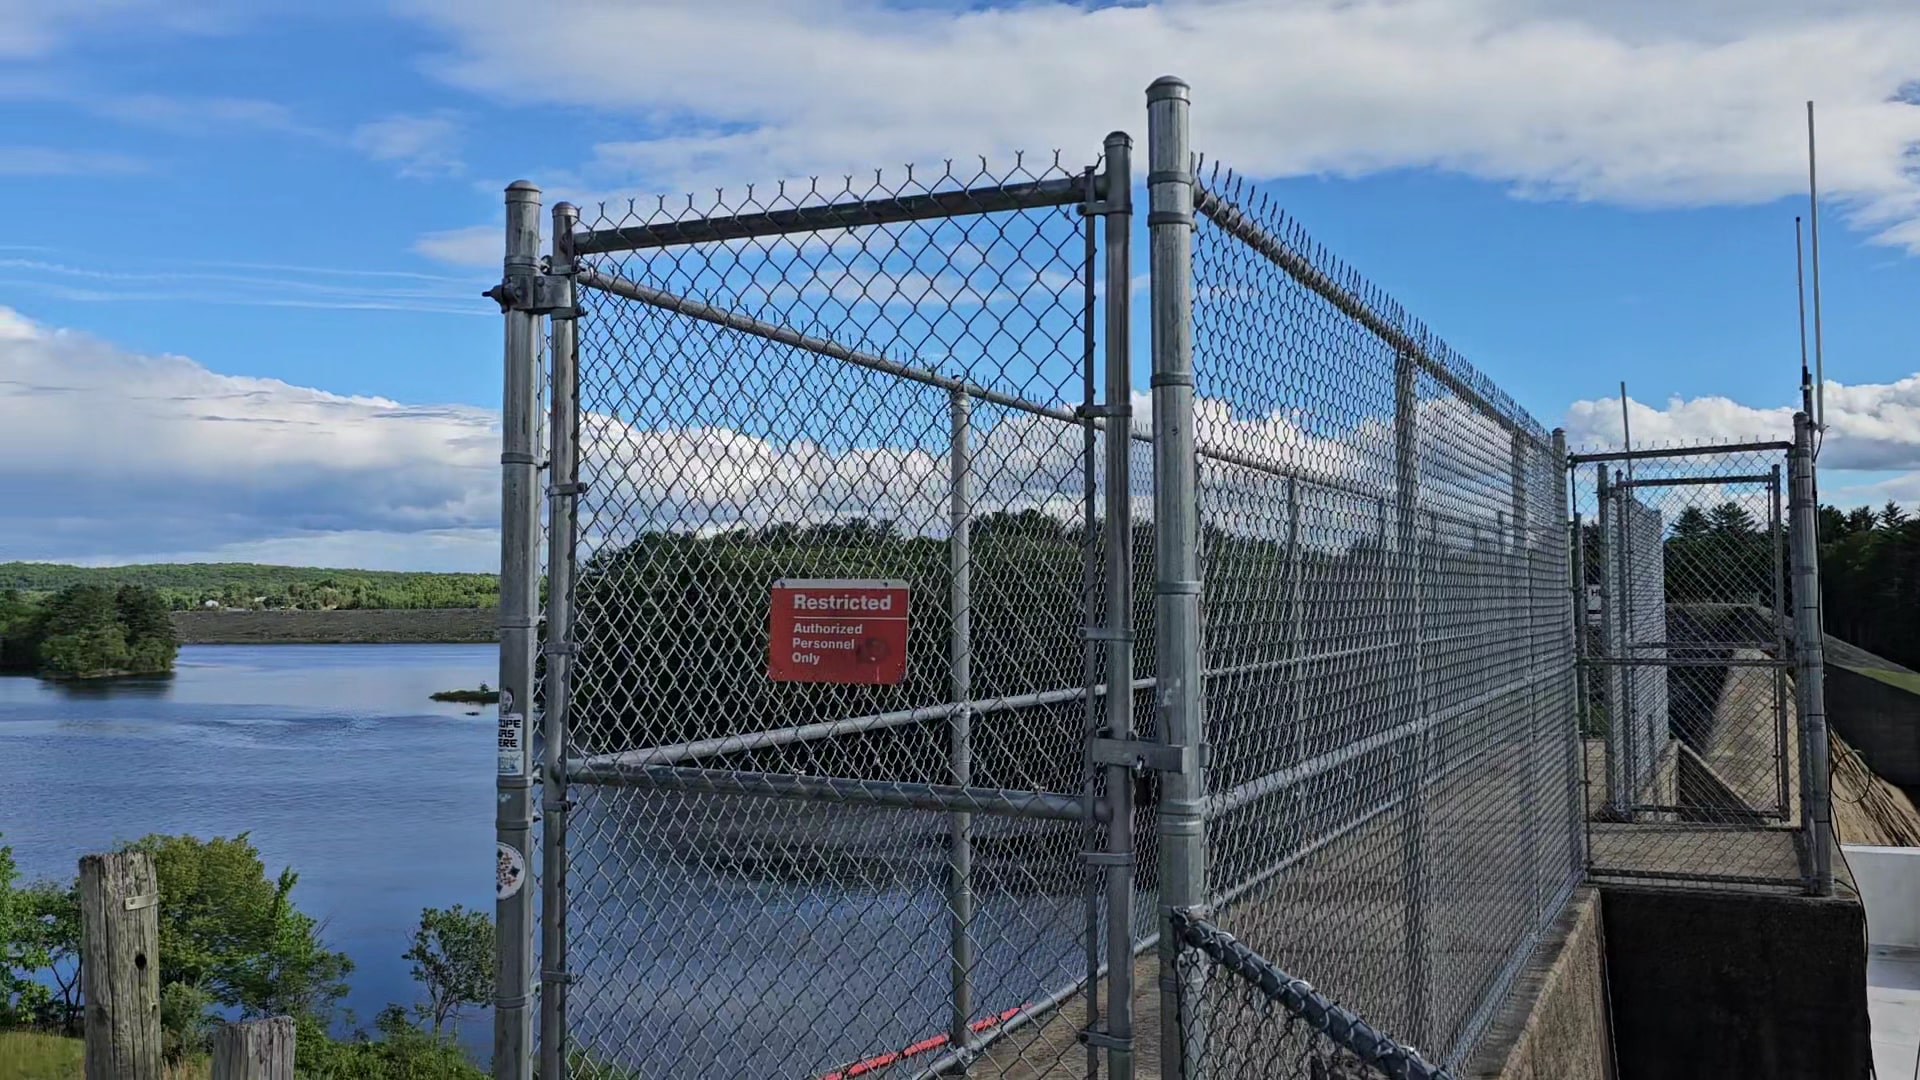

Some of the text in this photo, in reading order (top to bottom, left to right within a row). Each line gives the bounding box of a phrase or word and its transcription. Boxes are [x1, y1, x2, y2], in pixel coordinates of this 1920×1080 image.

[793, 594, 892, 610] Restricted
[793, 623, 863, 634] Authorized
[792, 638, 855, 650] Personnel
[792, 652, 820, 665] Only
